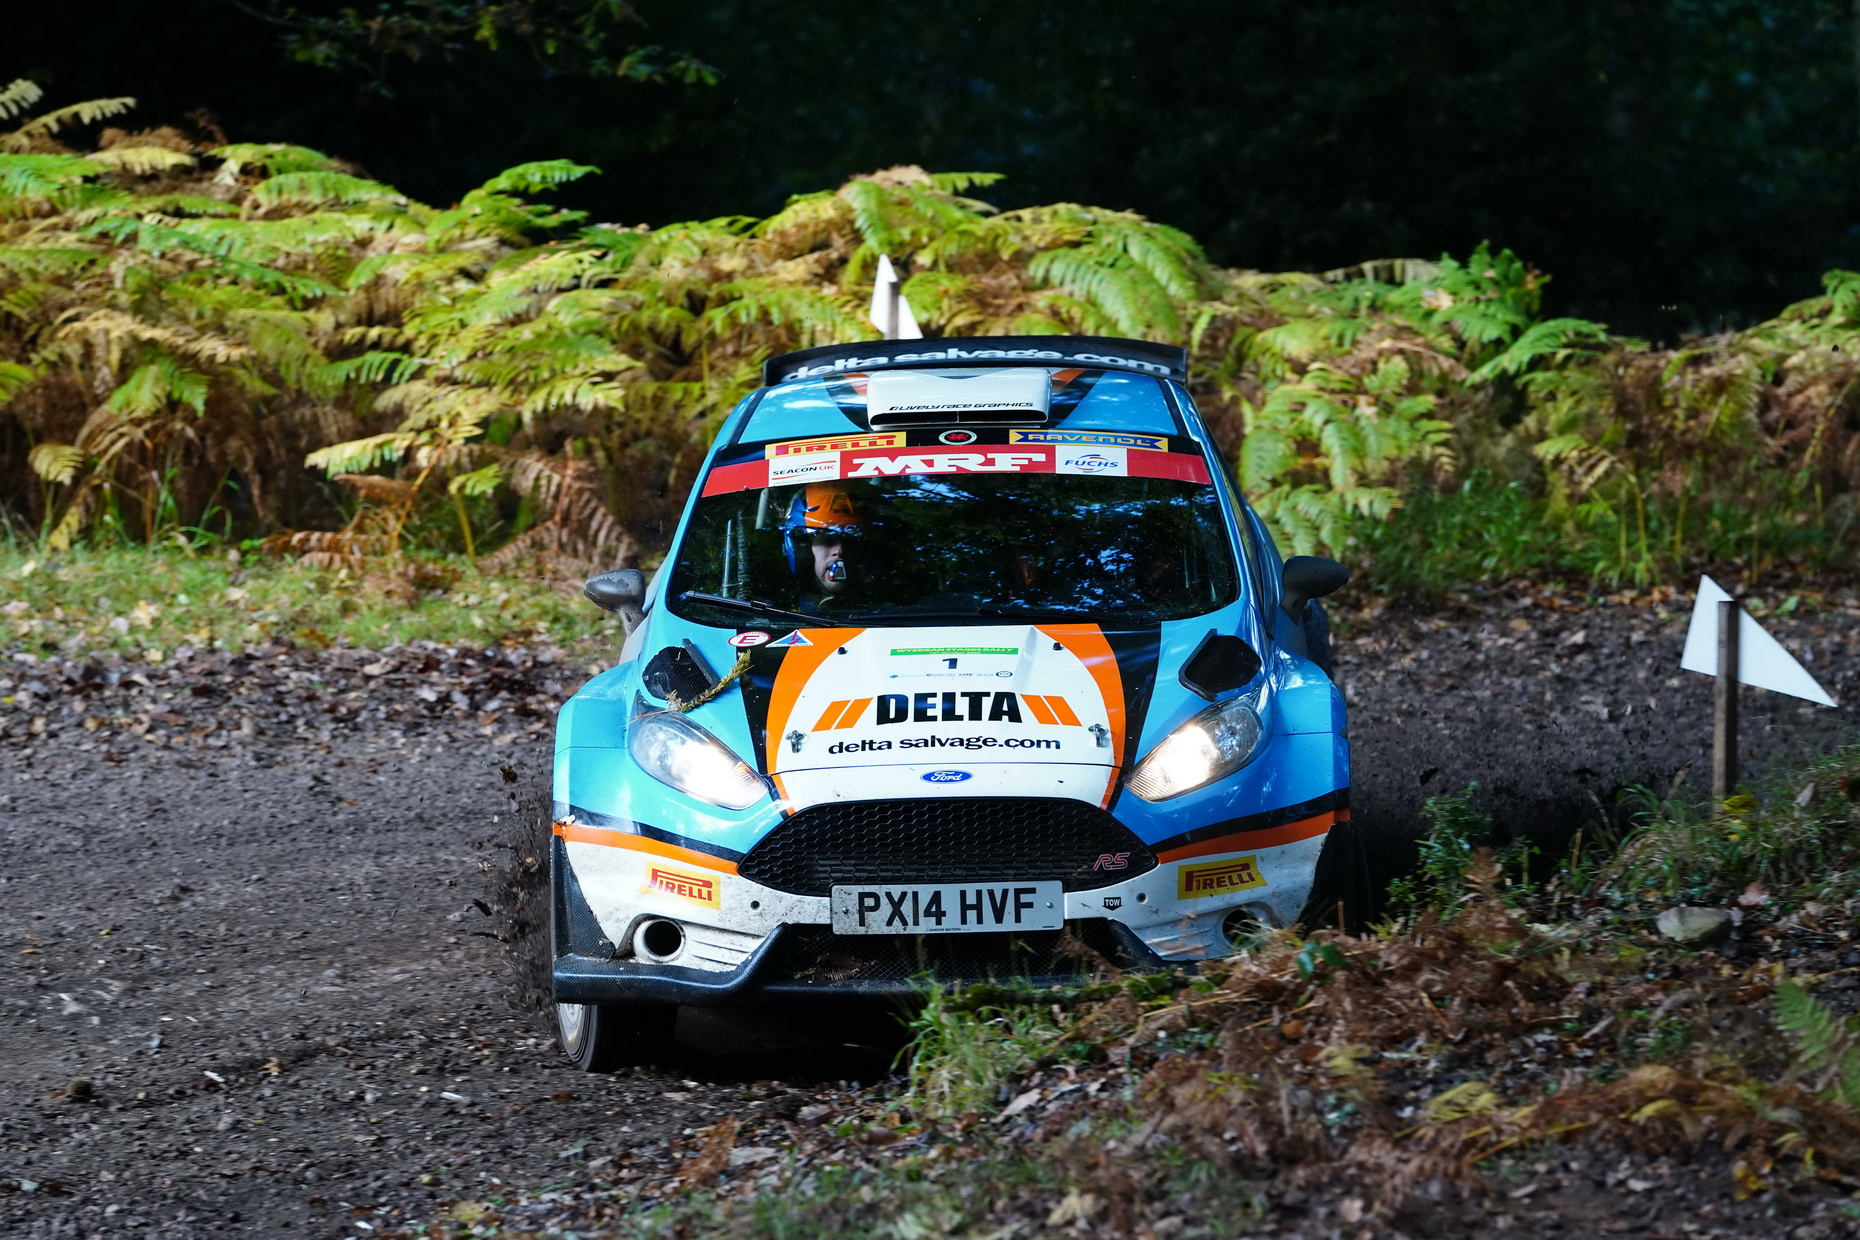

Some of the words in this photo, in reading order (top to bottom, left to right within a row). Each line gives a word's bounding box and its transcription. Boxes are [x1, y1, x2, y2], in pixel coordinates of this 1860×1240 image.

[781, 356, 889, 382] delta
[894, 347, 1171, 375] salvage.com
[775, 434, 897, 456] PIRELLI
[1027, 433, 1151, 446] RAVENOL
[773, 466, 818, 476] SEACON
[848, 453, 1046, 477] MRF
[1065, 459, 1119, 468] FUCHS
[738, 635, 760, 644] E
[942, 657, 958, 669] 1
[876, 691, 1023, 726] DELTA
[828, 739, 893, 755] delta
[899, 735, 1061, 750] salvage.com
[930, 770, 963, 782] Ford
[1093, 852, 1131, 872] RS
[648, 868, 713, 902] PIRELLI
[1185, 863, 1256, 892] PIRELLI
[857, 890, 947, 927] PX14
[959, 887, 1037, 926] HVF
[1104, 898, 1121, 907] TOW
